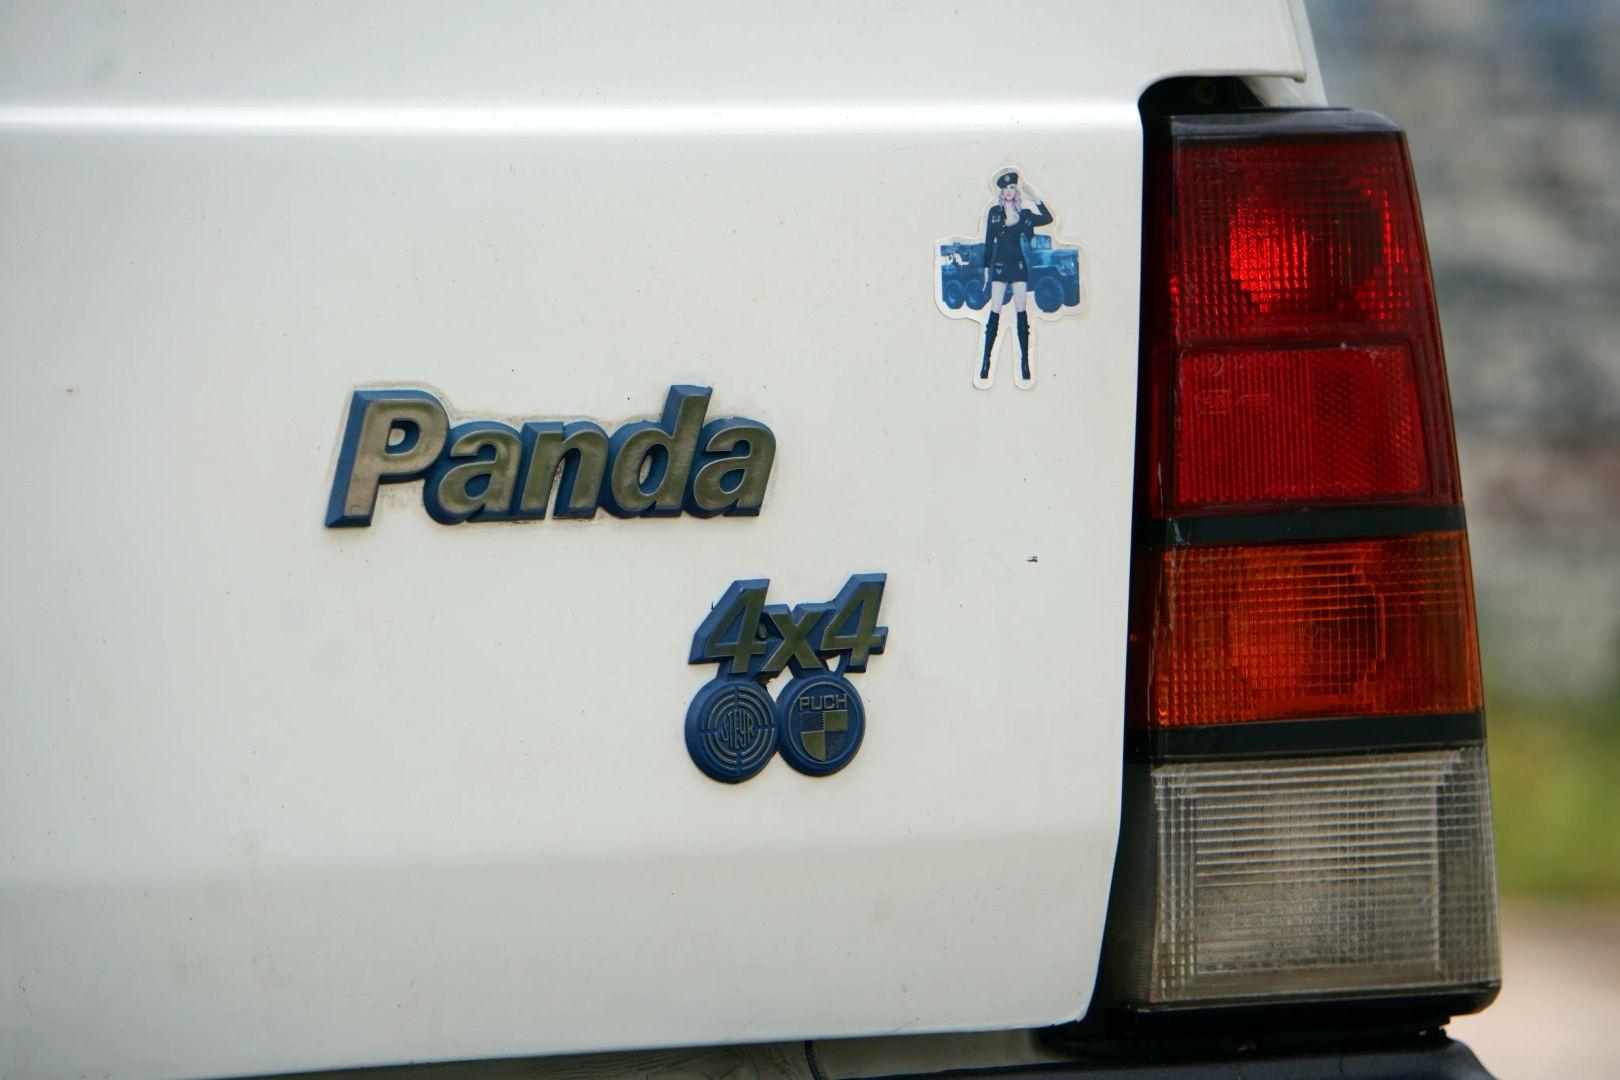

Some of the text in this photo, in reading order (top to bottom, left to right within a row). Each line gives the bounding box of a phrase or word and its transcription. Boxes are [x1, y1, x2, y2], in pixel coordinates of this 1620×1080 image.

[325, 384, 776, 527] Panda
[688, 573, 889, 674] 4x4
[721, 709, 754, 749] STEYR
[799, 693, 849, 711] PUCH
